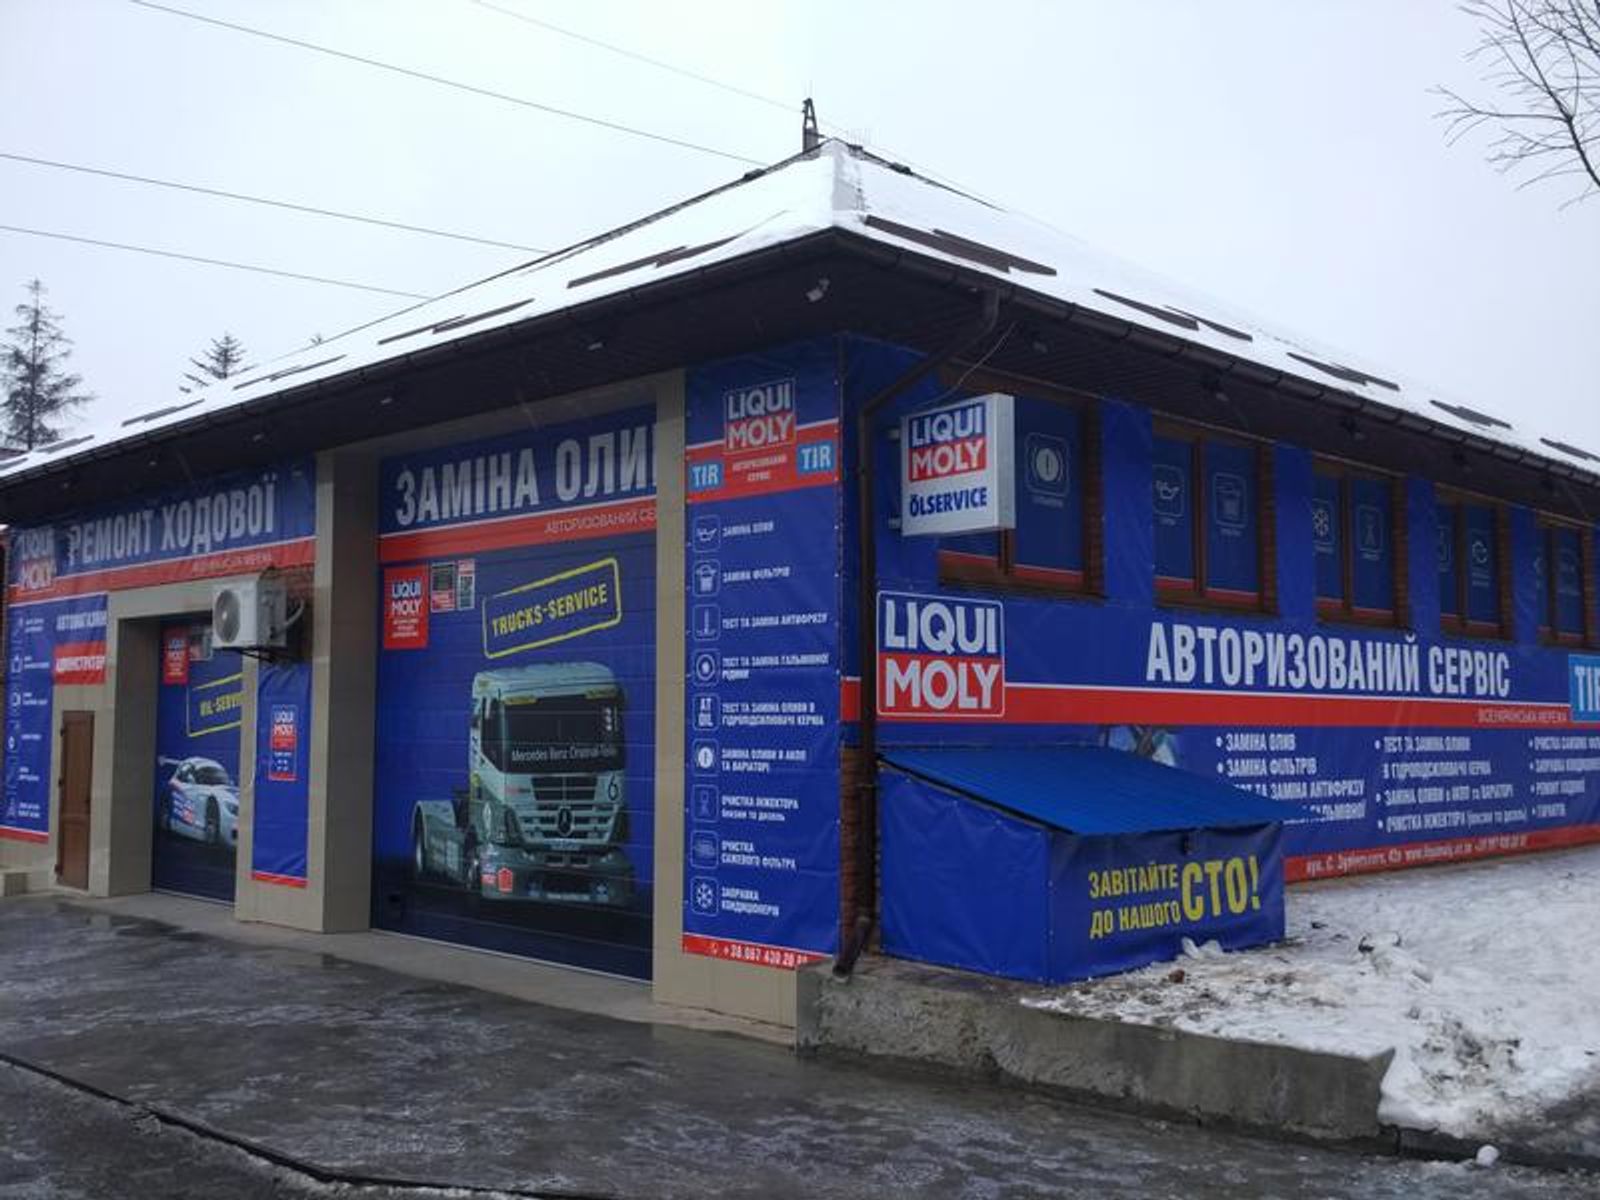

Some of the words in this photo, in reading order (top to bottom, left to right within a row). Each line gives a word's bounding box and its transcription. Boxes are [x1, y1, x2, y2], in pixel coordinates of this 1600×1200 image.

[728, 383, 791, 419] LIQUI
[728, 413, 793, 449] MOLY
[912, 405, 984, 447] LIQUI
[692, 464, 719, 488] TIR
[801, 445, 831, 470] TIR
[912, 439, 984, 479] MOLY
[396, 448, 539, 526] ЗАМІНА
[910, 487, 987, 517] ÖLSERVICE
[67, 510, 154, 565] РЕМОНТ
[161, 473, 277, 553] ХОДОВОЇ
[392, 580, 422, 598] LIQUI
[392, 599, 422, 616] MOLY
[492, 583, 608, 638] TRUCKS-SERVICE
[885, 600, 998, 655] LIQUI
[1146, 621, 1420, 692] АВТОРИЗОВАНИЙ
[1428, 645, 1511, 697] СЕРВІС
[885, 658, 1000, 709] MOLY
[1226, 733, 1267, 751] ЗАМІНА
[1226, 758, 1267, 777] ЗАМІНА
[1089, 860, 1178, 898] ЗАВІТАЙТЕ
[1181, 856, 1261, 921] СТО!
[1090, 910, 1113, 939] ДО
[1119, 901, 1181, 931] НАШОГО
